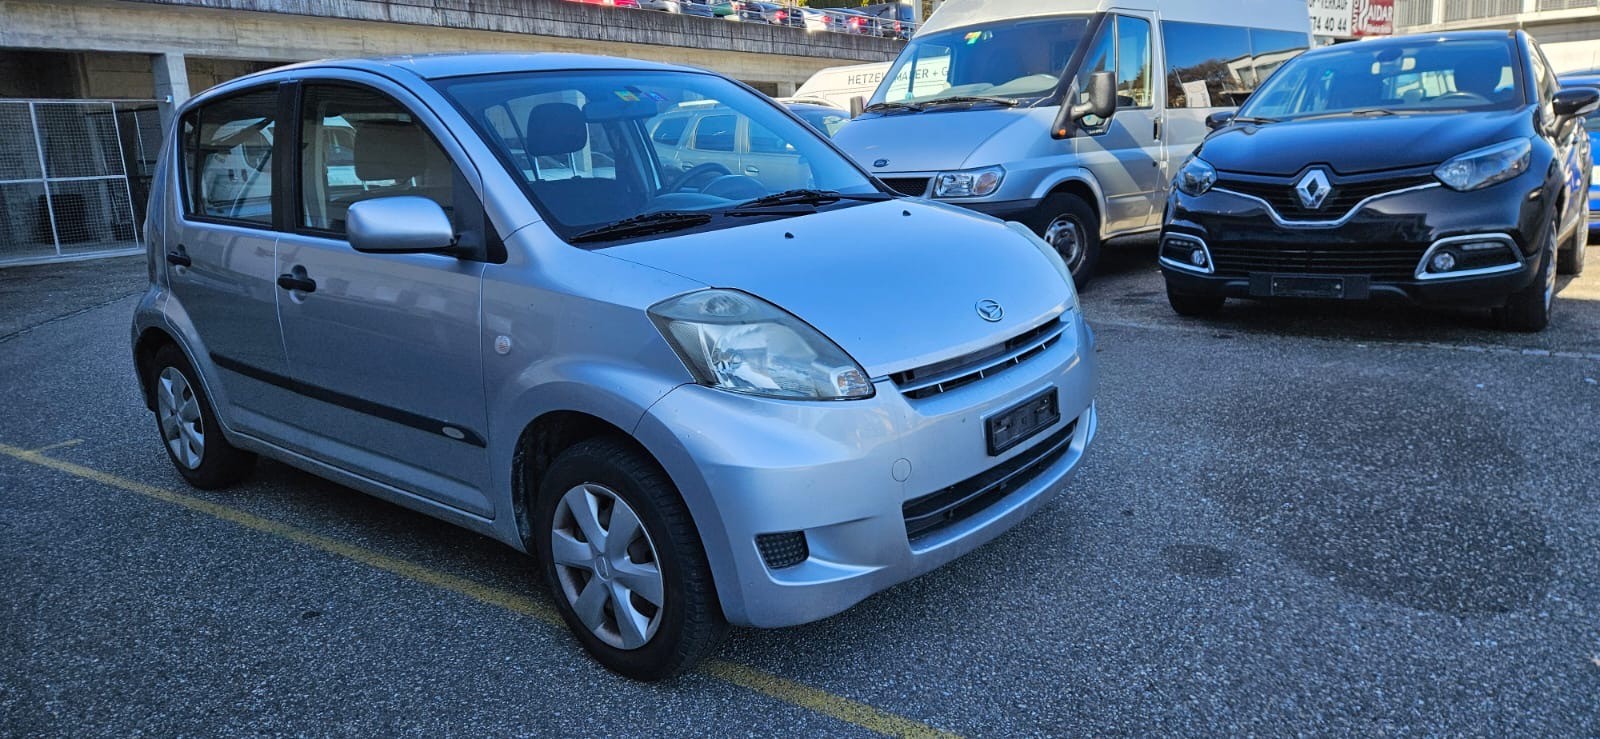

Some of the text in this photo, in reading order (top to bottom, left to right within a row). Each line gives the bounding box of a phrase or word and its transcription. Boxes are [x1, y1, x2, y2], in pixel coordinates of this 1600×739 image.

[1325, 17, 1335, 32] 40
[1337, 17, 1347, 32] 44
[896, 69, 929, 82] MAER
